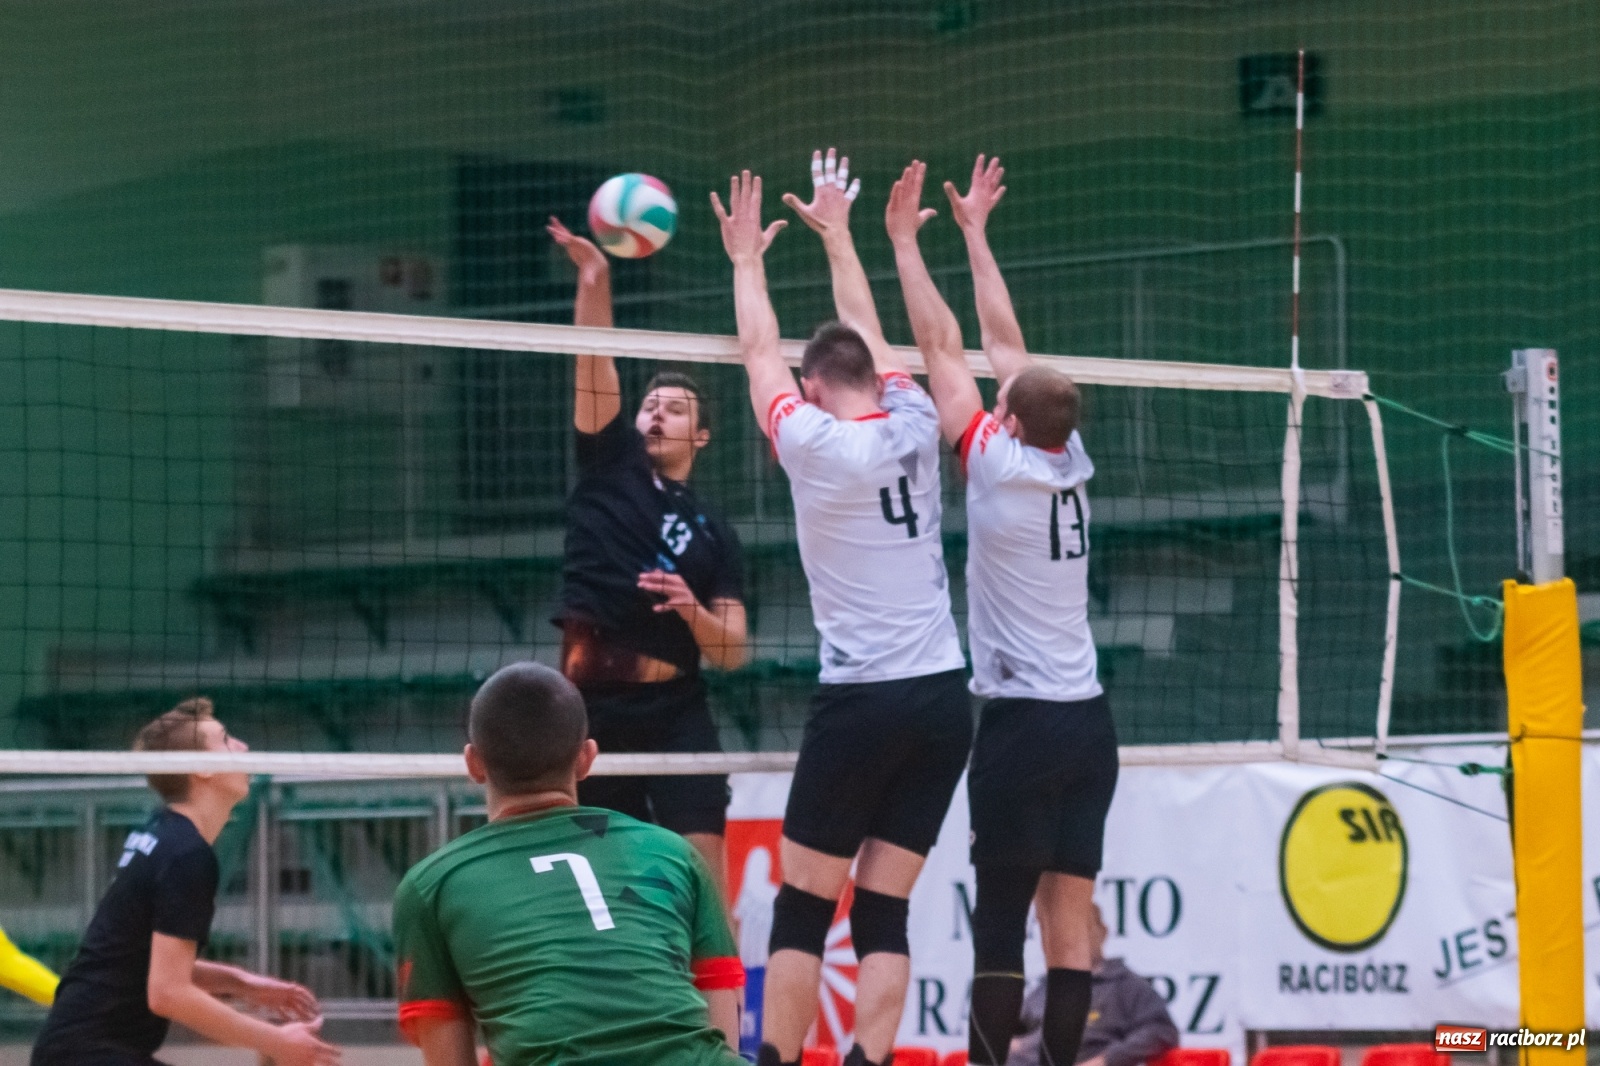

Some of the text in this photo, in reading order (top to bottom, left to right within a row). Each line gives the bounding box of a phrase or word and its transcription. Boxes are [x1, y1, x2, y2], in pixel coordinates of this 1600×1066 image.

[879, 475, 918, 539] 4
[1050, 487, 1087, 561] 13
[529, 852, 616, 931] 7
[1278, 958, 1409, 994] RACIBÓRZ
[1434, 911, 1518, 979] JES
